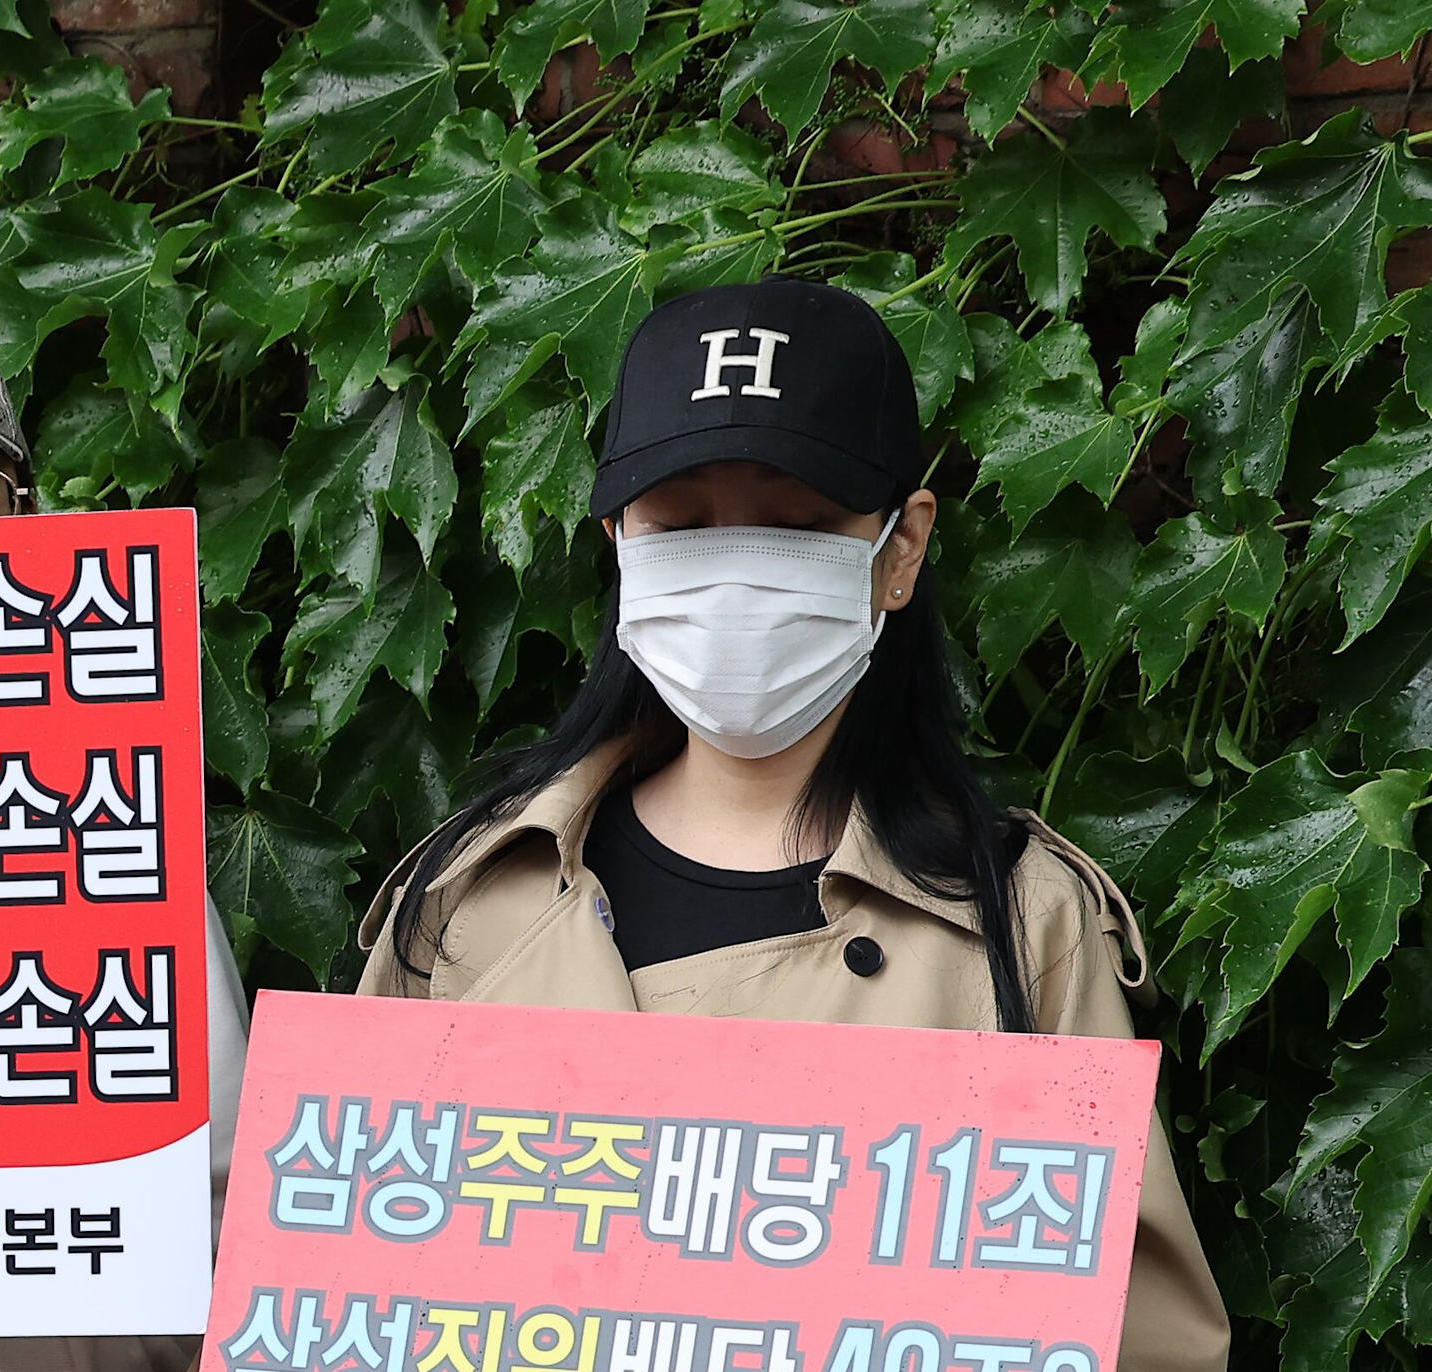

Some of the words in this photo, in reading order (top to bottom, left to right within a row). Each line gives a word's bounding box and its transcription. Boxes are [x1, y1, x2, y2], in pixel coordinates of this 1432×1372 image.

[691, 327, 790, 402] H
[266, 1094, 849, 1268] 삼성주주배당
[863, 1123, 1118, 1277] 11조!
